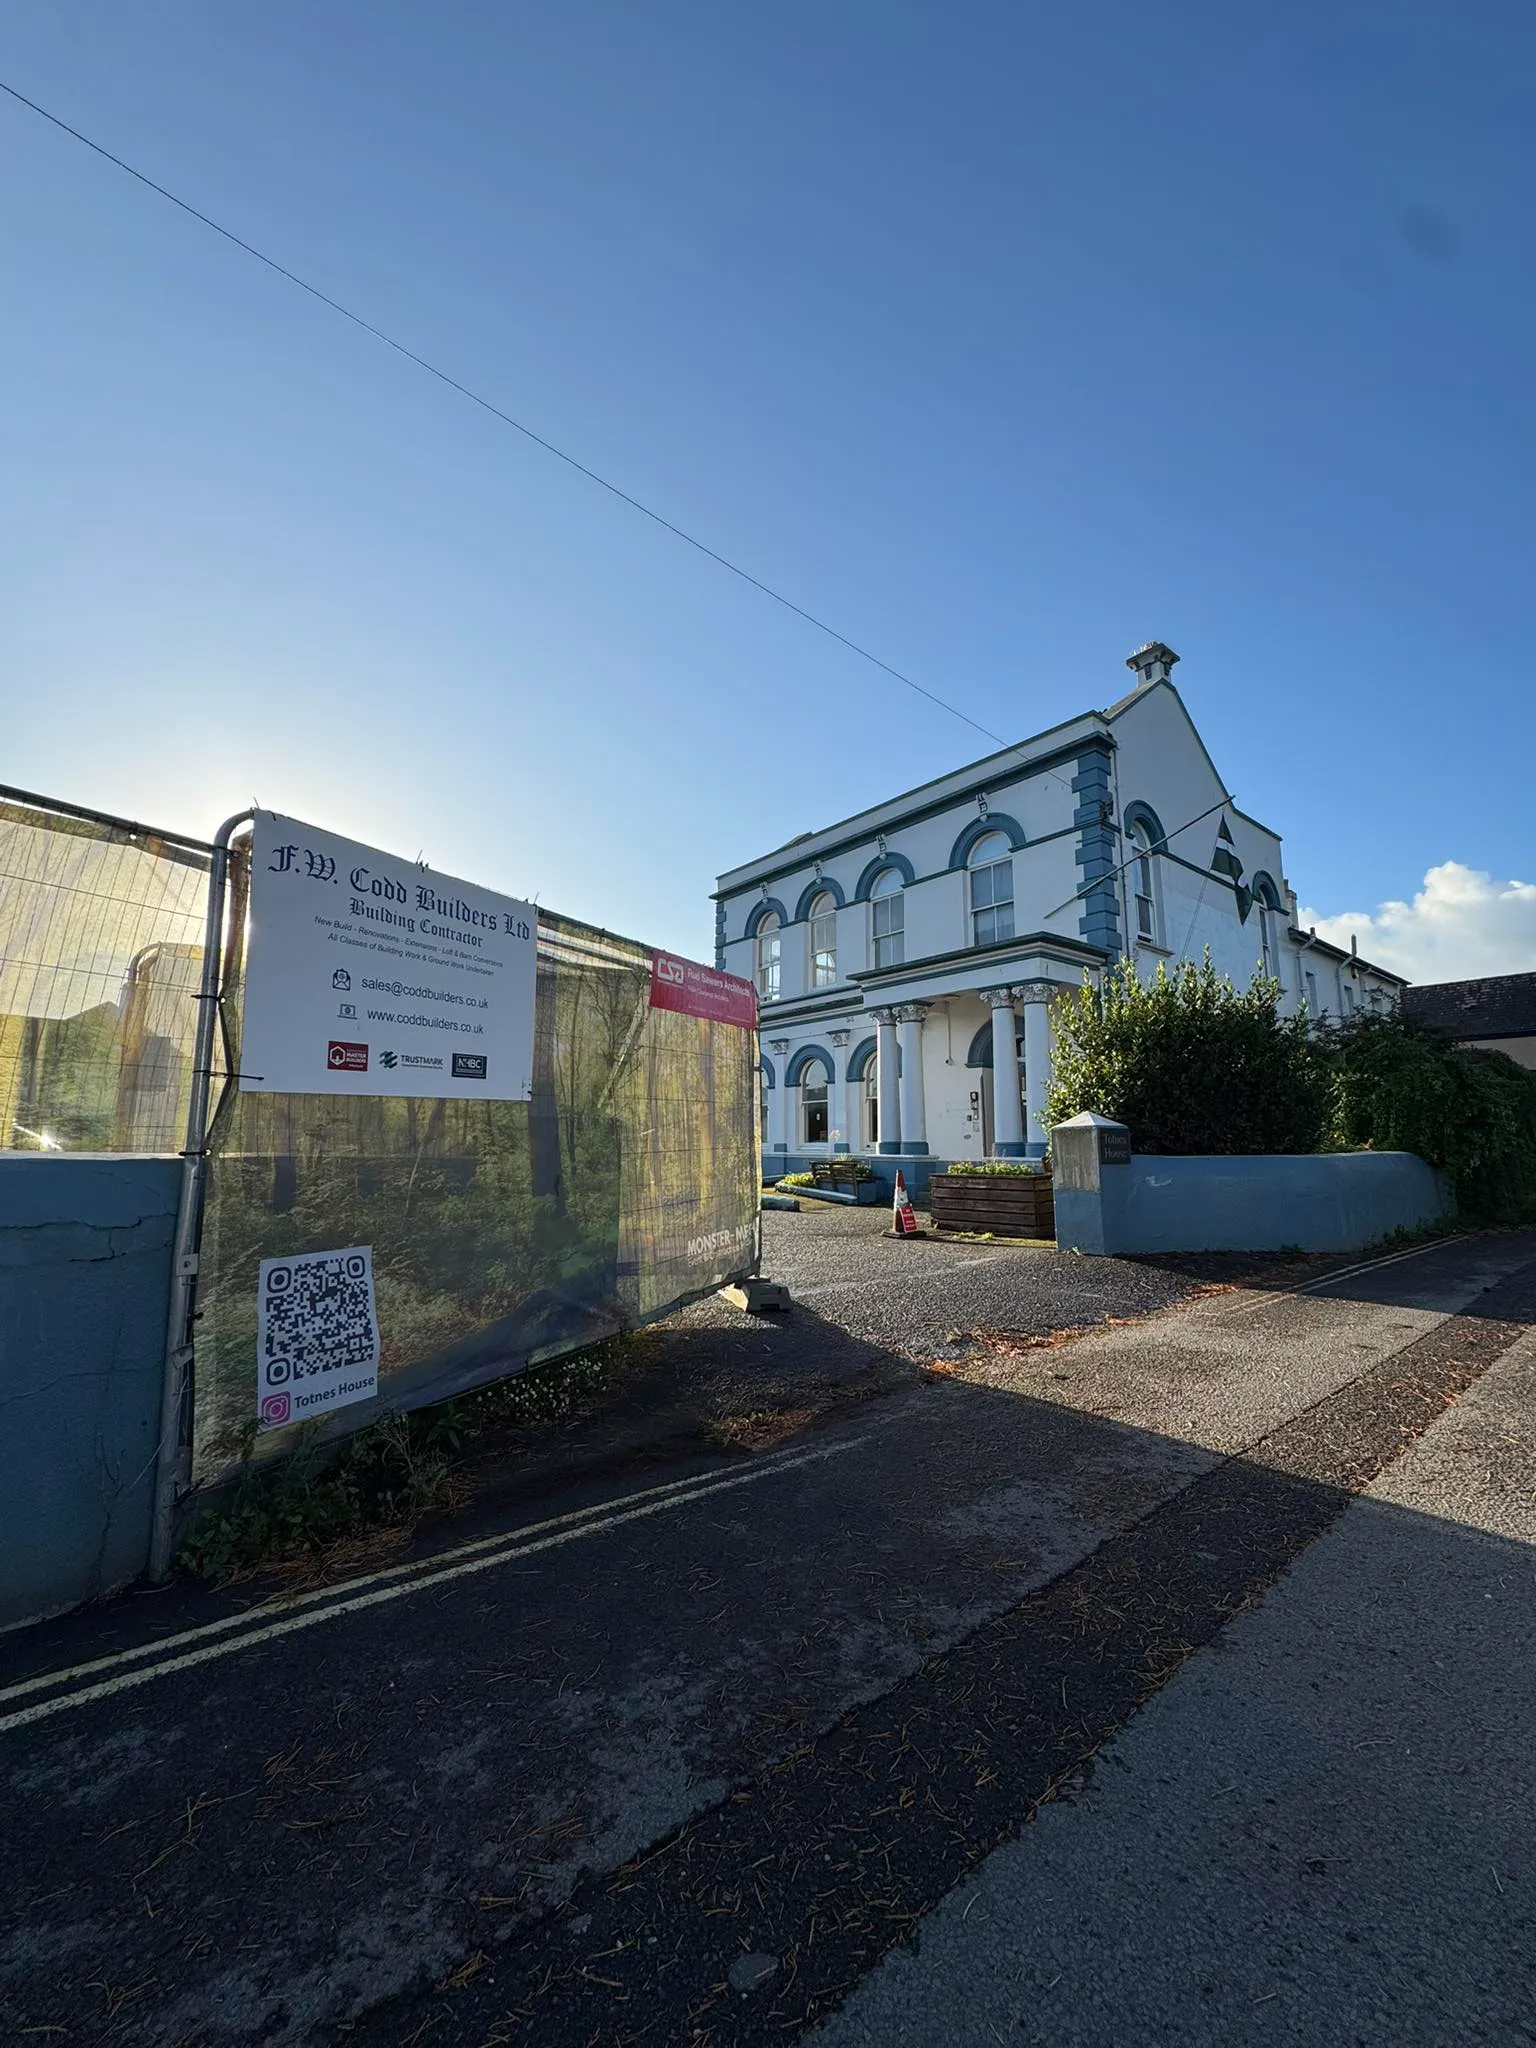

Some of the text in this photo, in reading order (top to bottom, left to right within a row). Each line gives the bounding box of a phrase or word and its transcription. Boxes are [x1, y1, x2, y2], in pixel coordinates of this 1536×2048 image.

[350, 867, 407, 904] Codd
[416, 885, 498, 931] Builders
[503, 913, 530, 940] Ltd
[314, 916, 332, 927] New
[333, 920, 352, 931] Build
[358, 926, 399, 943] Renovations
[405, 938, 437, 952] Extensions
[349, 897, 483, 948] Building Contractor
[328, 932, 338, 941] All
[340, 935, 368, 948] Classes
[377, 944, 404, 957] Building
[405, 950, 421, 960] Work
[428, 955, 450, 967] Ground
[450, 961, 464, 970] Work
[361, 978, 489, 1009] sales@coddbuilders.co.uk
[367, 1009, 484, 1035] www.coddbuilders.co.uk
[400, 1055, 443, 1066] TRUSTMARK
[458, 1057, 482, 1069] NHBC
[294, 1376, 375, 1409] Totnes House
